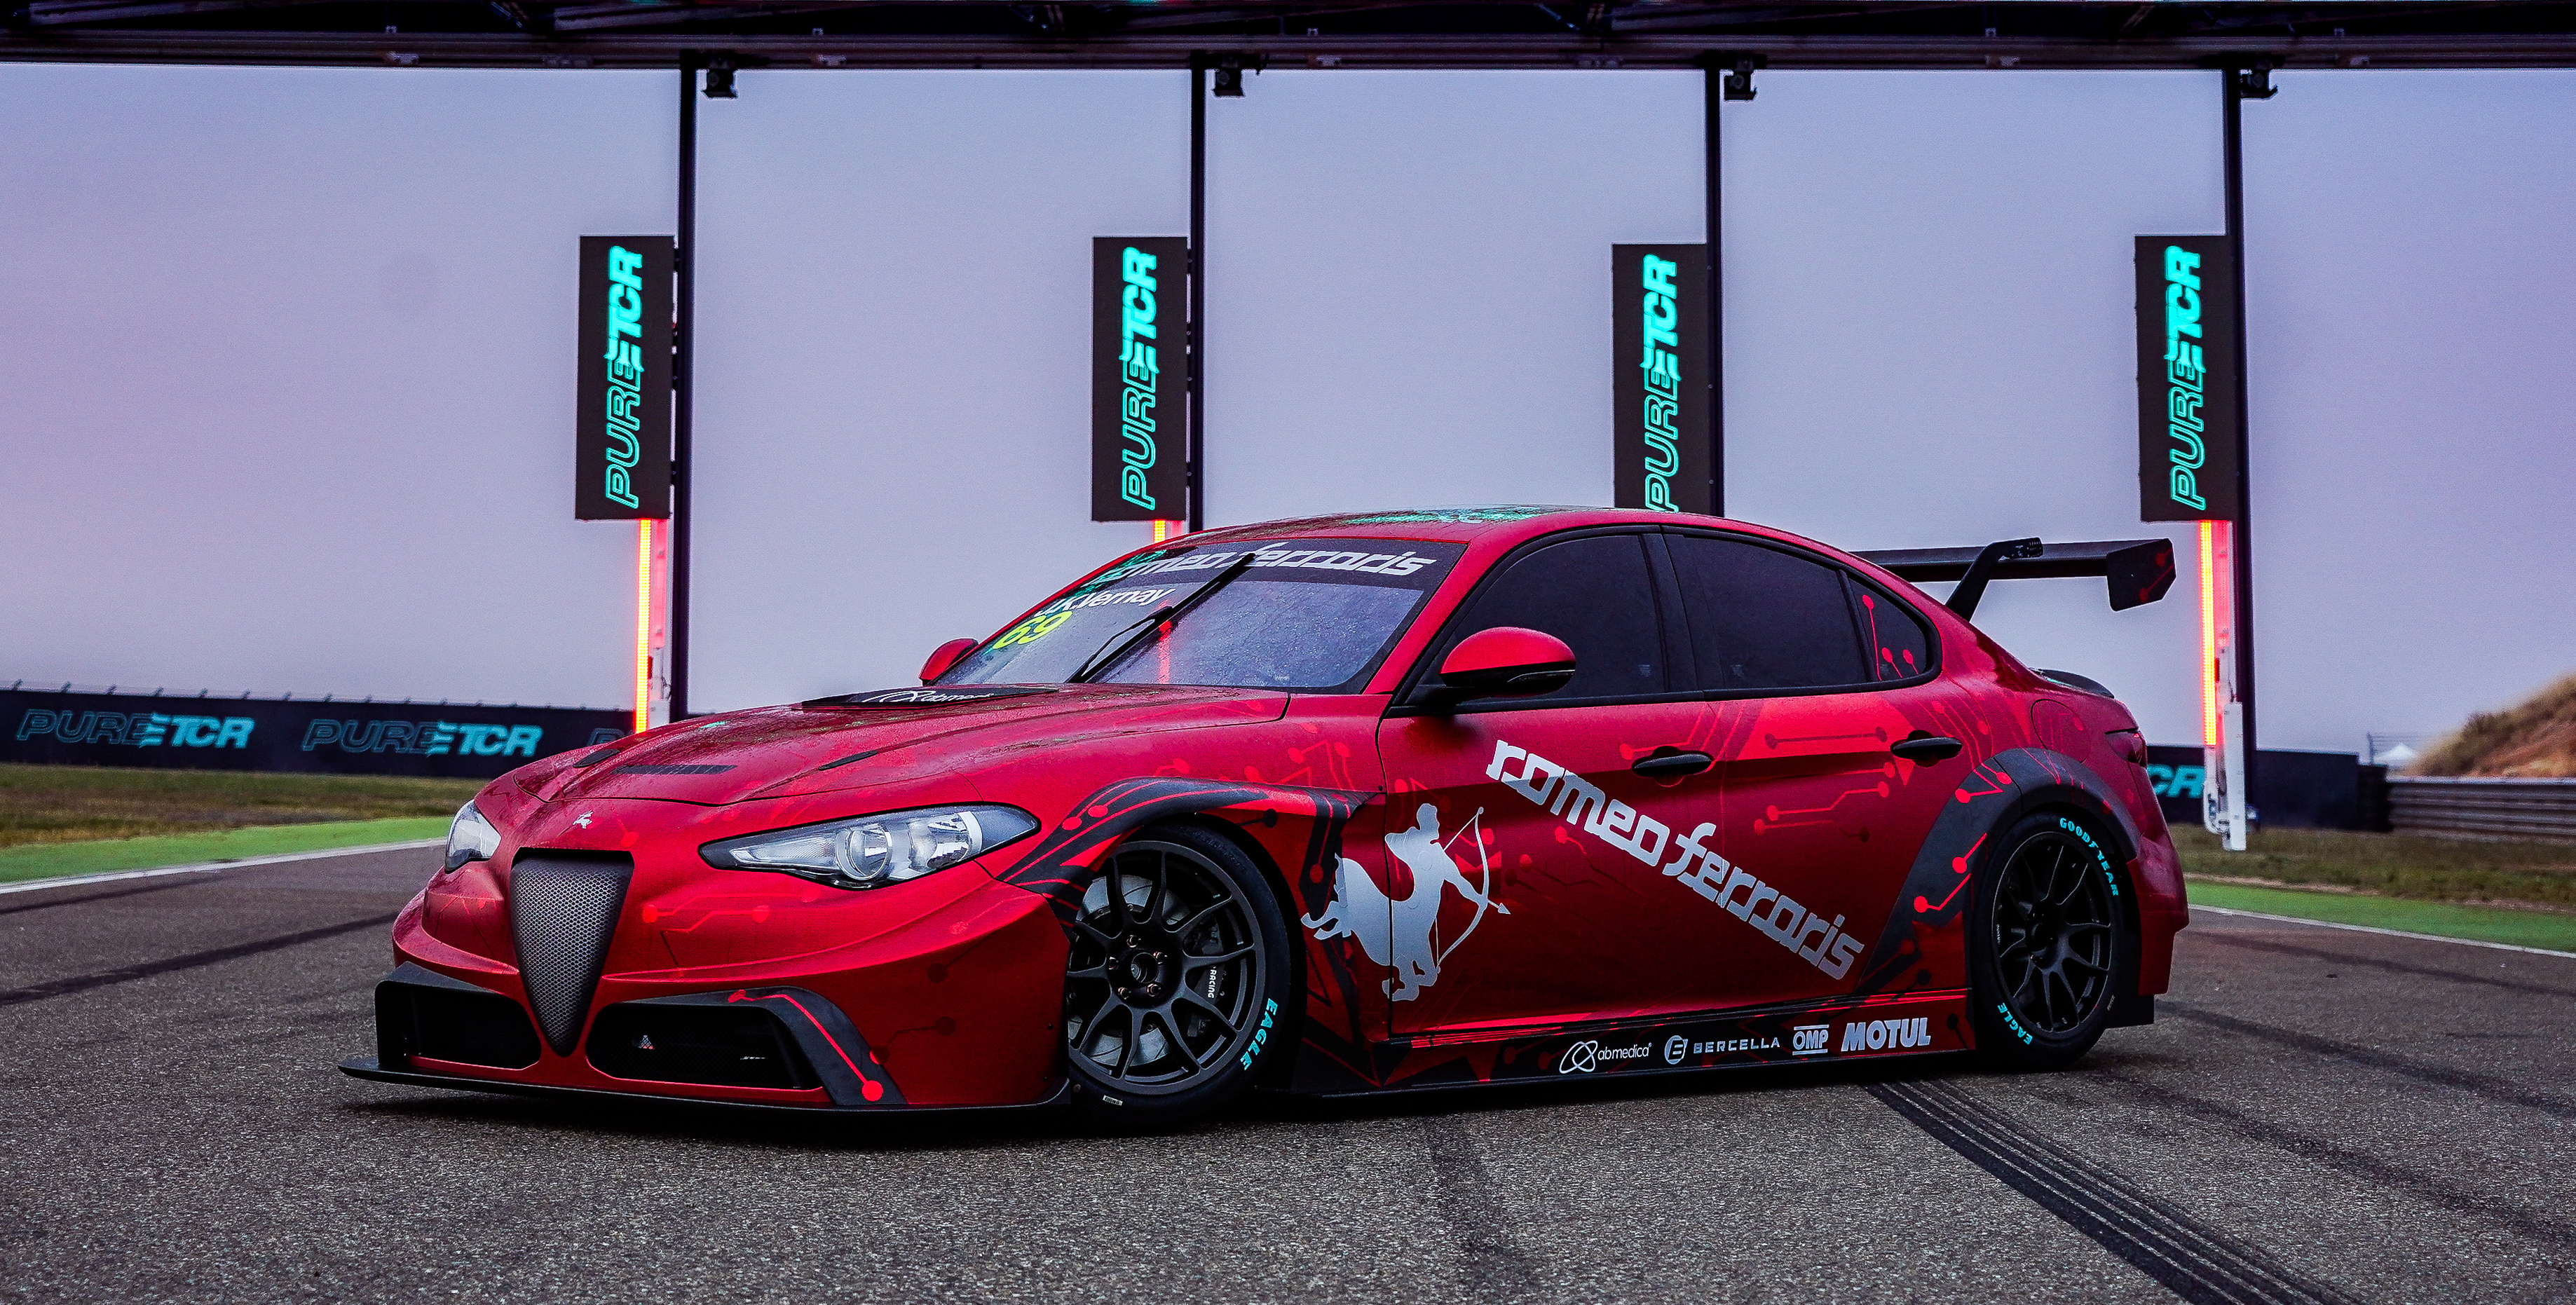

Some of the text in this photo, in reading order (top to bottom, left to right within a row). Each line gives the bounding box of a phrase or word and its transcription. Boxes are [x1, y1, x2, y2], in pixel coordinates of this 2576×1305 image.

[993, 611, 1073, 650] 69
[1485, 739, 1865, 980] romeo ferraris
[2059, 817, 2118, 897] GOODYEAR
[1207, 969, 1218, 999] RACING
[1240, 997, 1279, 1071] EAGLE
[1793, 1029, 1829, 1051] OMP
[1840, 1017, 1931, 1052] MOTUL
[1997, 1002, 2033, 1046] EAGLE
[1693, 1037, 1780, 1054] BERCELLA
